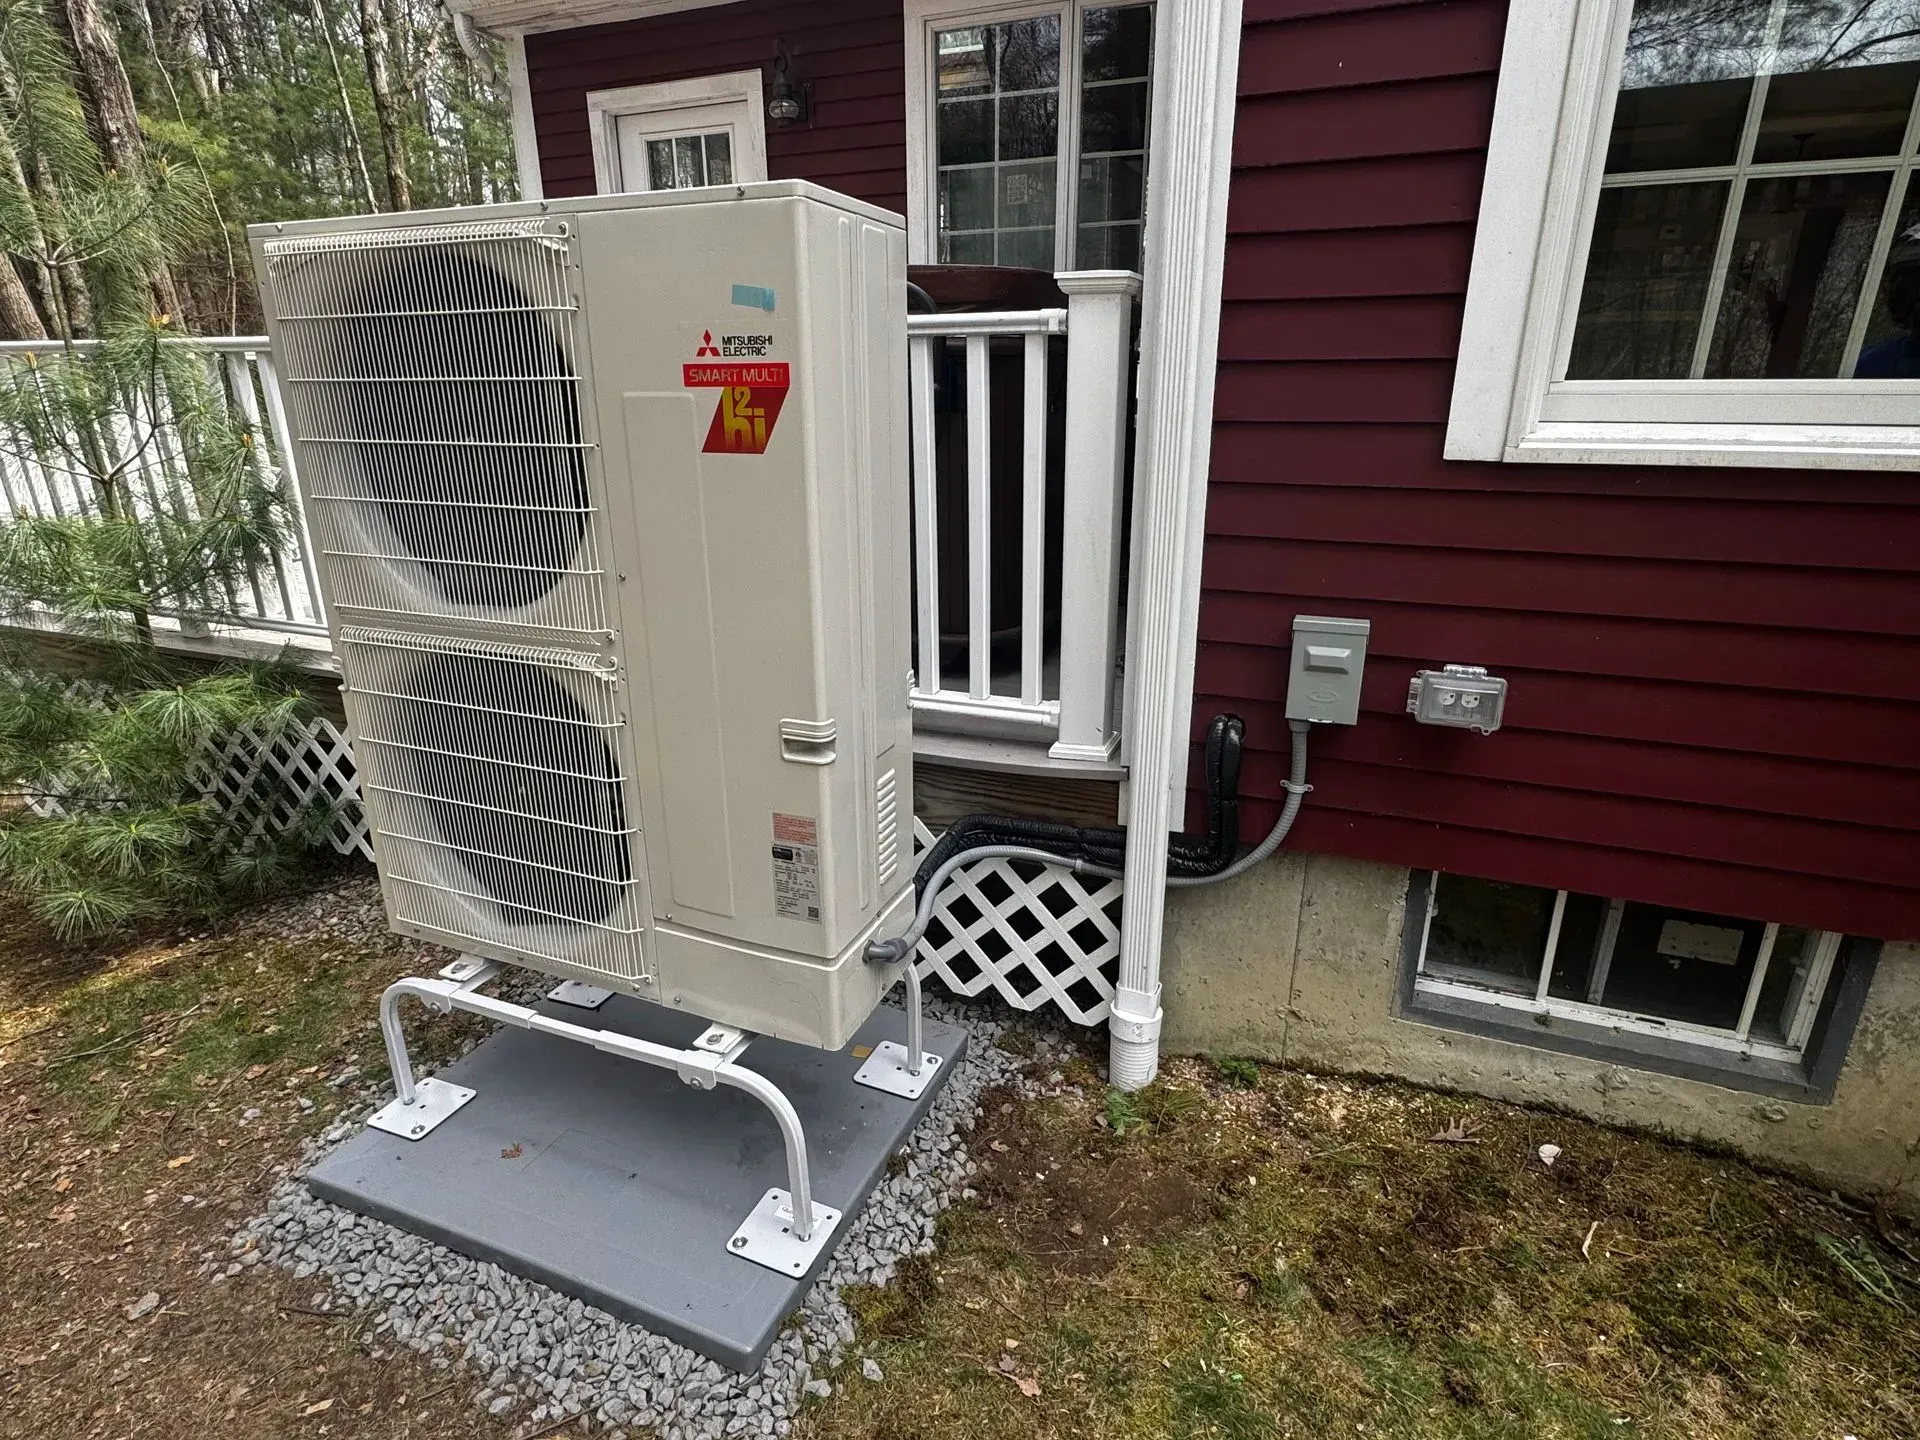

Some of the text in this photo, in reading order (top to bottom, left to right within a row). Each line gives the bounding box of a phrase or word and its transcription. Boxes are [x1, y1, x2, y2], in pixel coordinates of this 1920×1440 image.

[722, 335, 773, 346] MITSUBISHI
[723, 346, 767, 357] ELECTRIC
[689, 368, 784, 382] SMART MULTI
